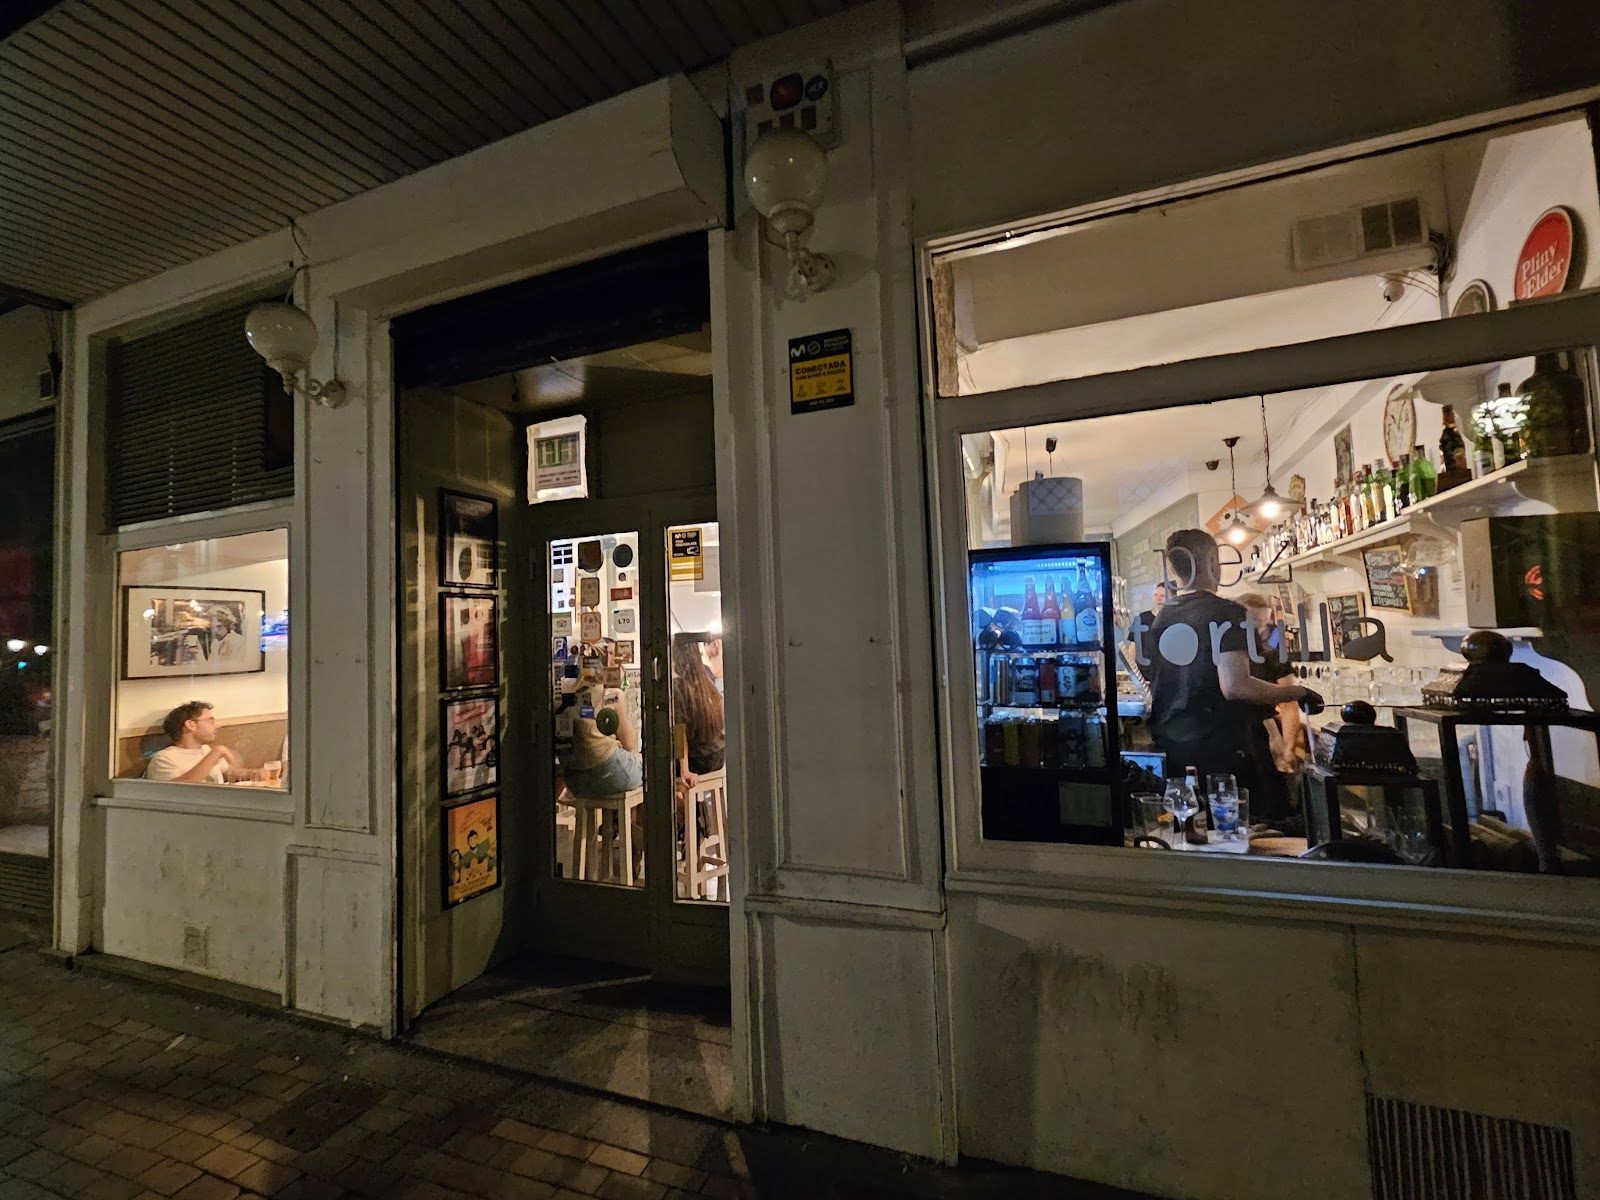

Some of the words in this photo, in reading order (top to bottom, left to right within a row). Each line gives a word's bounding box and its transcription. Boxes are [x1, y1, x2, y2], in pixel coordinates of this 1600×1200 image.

[1522, 240, 1559, 282] Pliny
[1528, 258, 1564, 299] Elder
[795, 360, 846, 375] CONECTADA
[1129, 602, 1394, 666] tortilla
